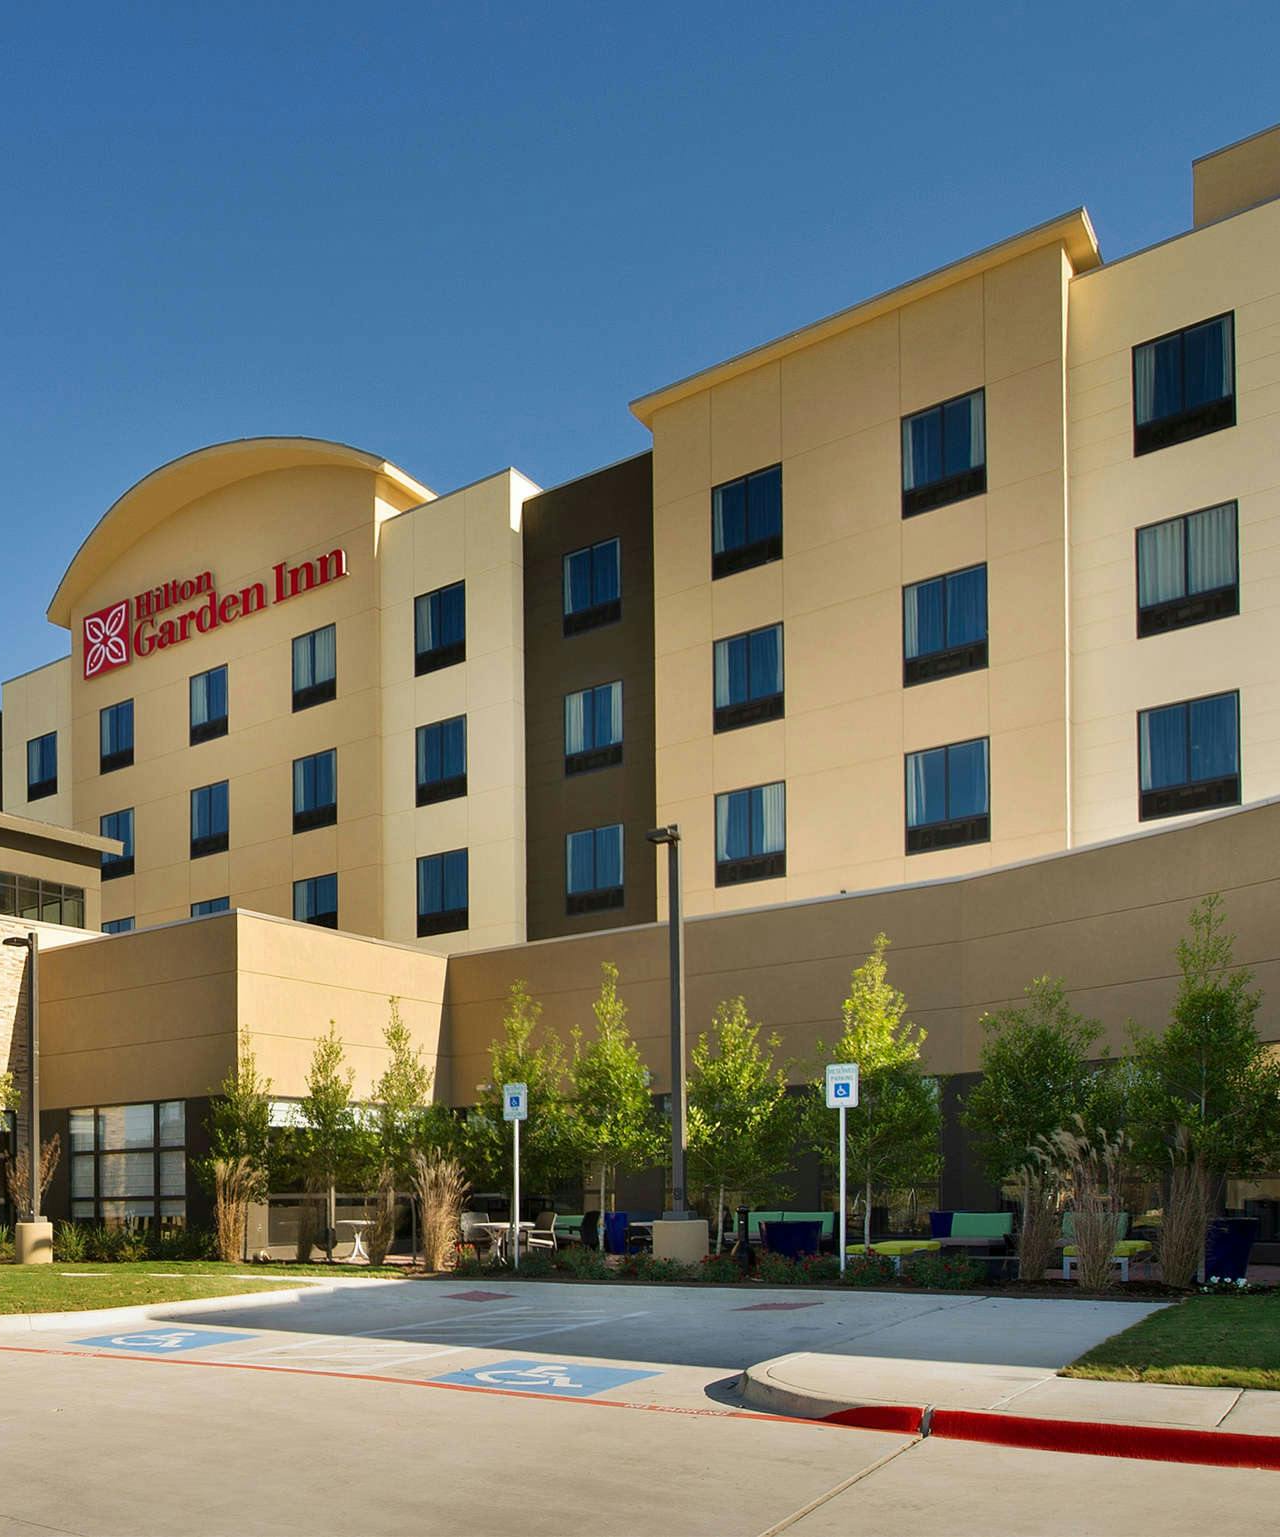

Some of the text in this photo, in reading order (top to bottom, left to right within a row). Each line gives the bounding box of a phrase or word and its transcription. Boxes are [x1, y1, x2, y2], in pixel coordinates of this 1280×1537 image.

[133, 547, 351, 658] Garden Inn
[134, 570, 213, 621] Hilton
